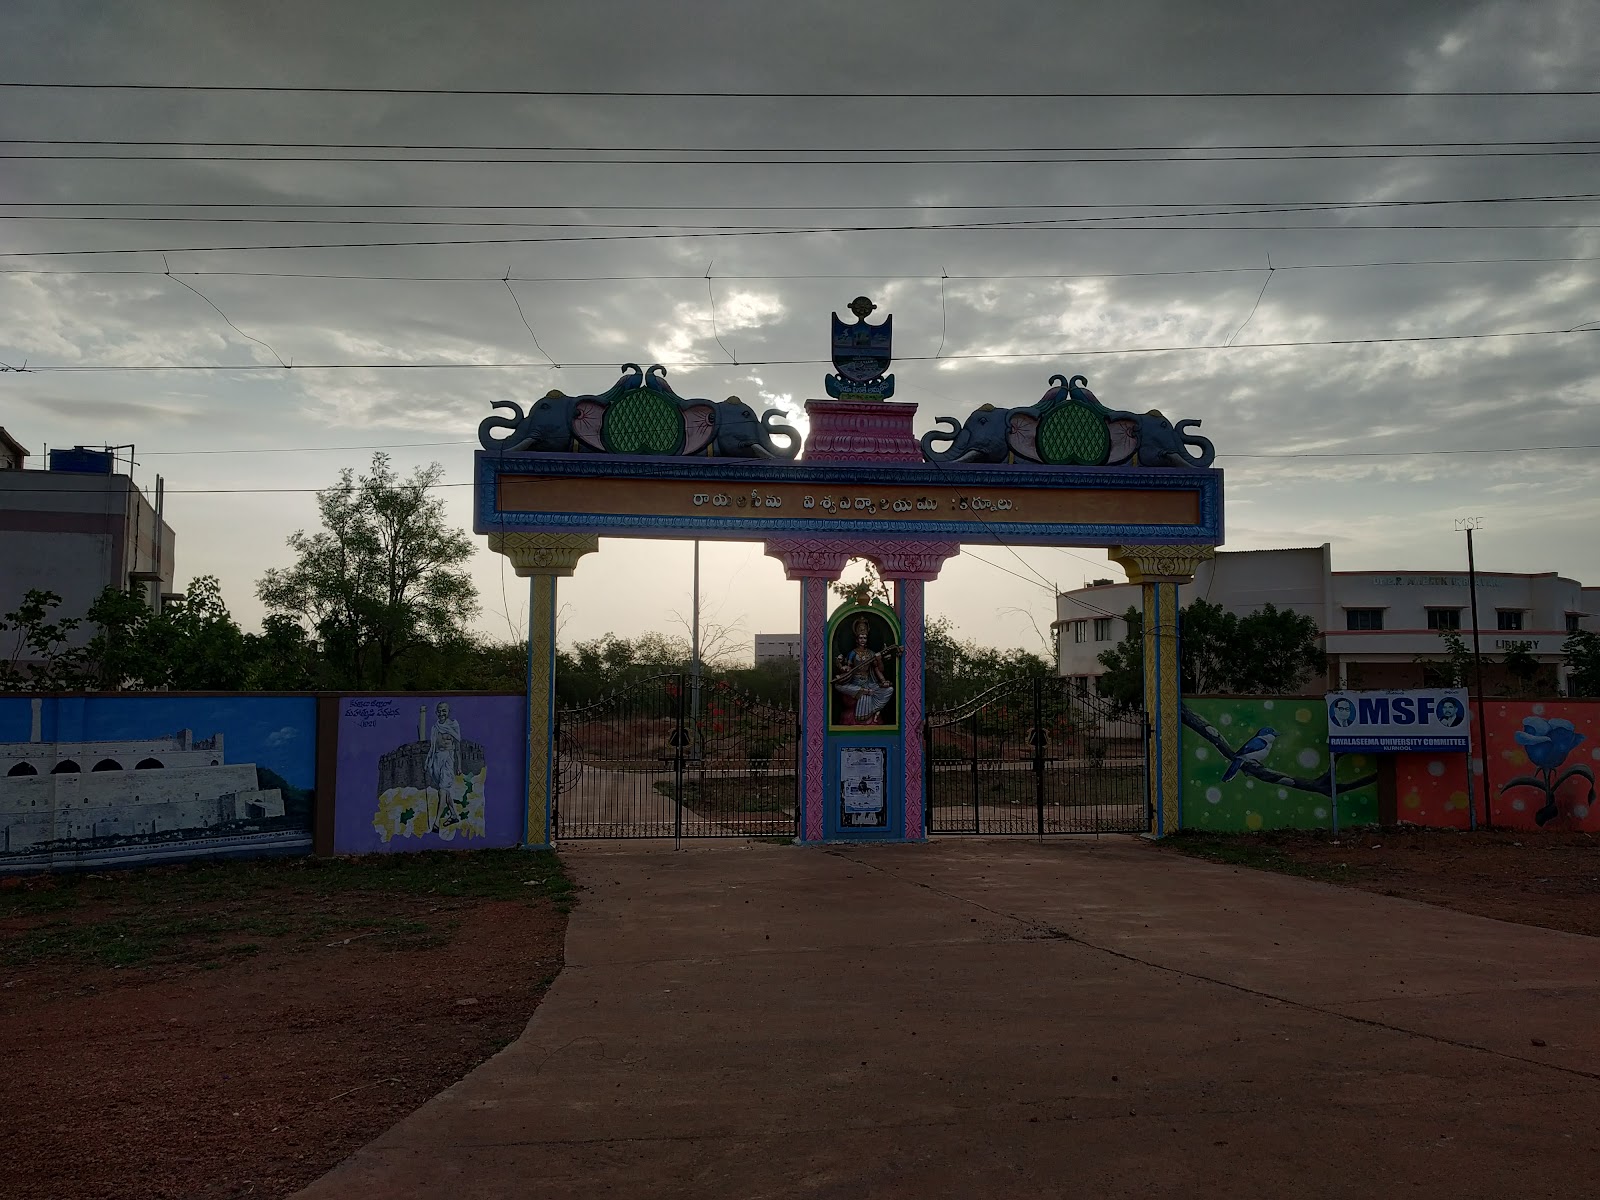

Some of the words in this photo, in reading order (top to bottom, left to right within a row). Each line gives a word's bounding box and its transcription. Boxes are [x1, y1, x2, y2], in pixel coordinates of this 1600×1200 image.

[1358, 697, 1435, 725] MSF
[1331, 738, 1379, 746] RAYALASEEMA
[1380, 738, 1422, 746] UNIVERSITY
[1423, 738, 1466, 746] COMMITTEE
